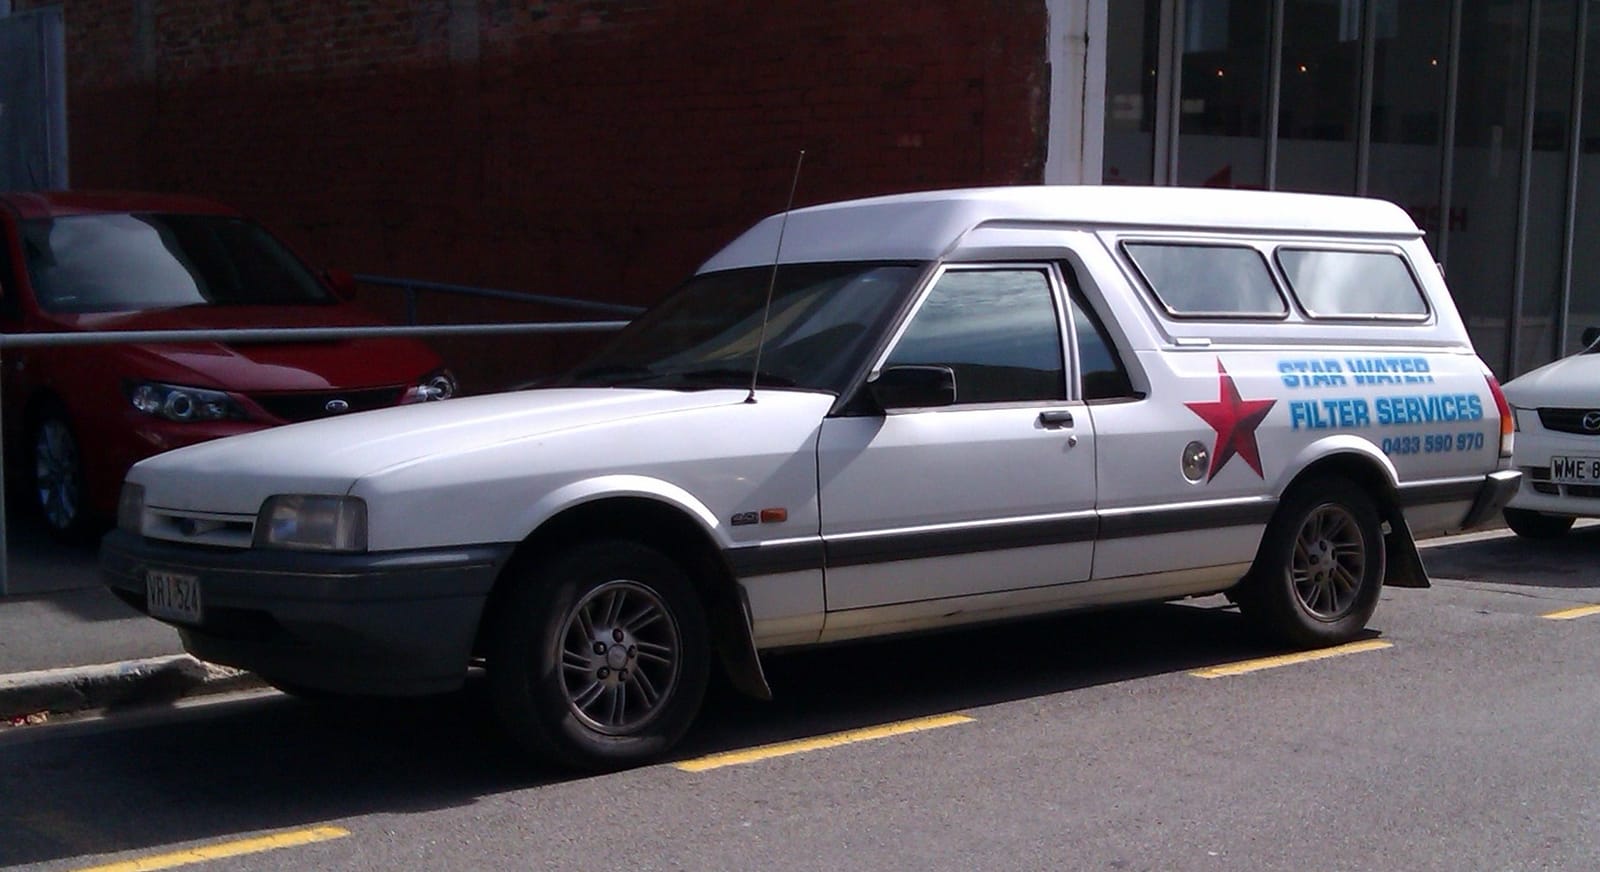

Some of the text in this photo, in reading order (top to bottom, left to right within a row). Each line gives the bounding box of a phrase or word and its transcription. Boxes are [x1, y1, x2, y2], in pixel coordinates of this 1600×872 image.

[1278, 356, 1435, 387] STAR WATER
[1290, 392, 1484, 431] FILTER SERVICES
[1382, 431, 1485, 455] 0433 590 970
[1554, 457, 1586, 479] WME
